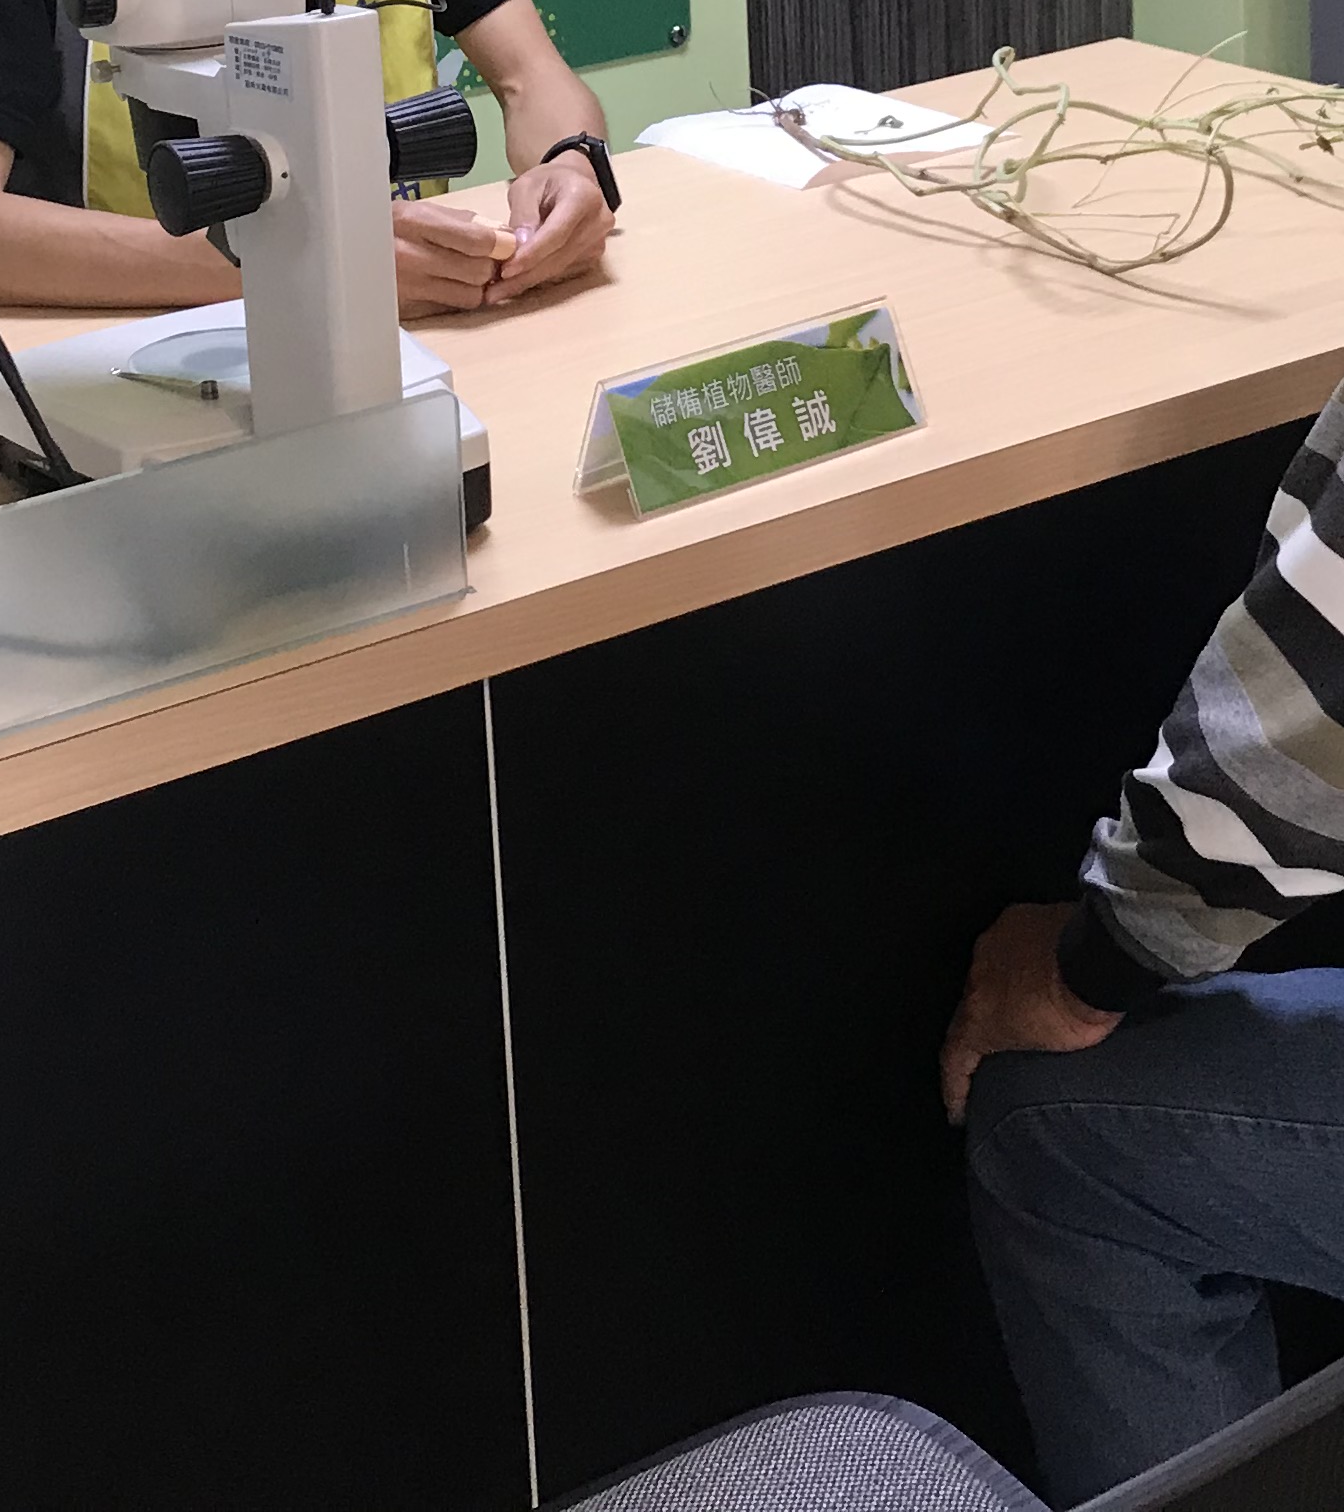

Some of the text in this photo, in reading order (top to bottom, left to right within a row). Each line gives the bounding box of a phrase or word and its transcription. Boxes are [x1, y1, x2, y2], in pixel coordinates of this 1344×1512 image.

[650, 355, 803, 429] 儲備植物醫師
[687, 390, 836, 476] 劉偉誠
